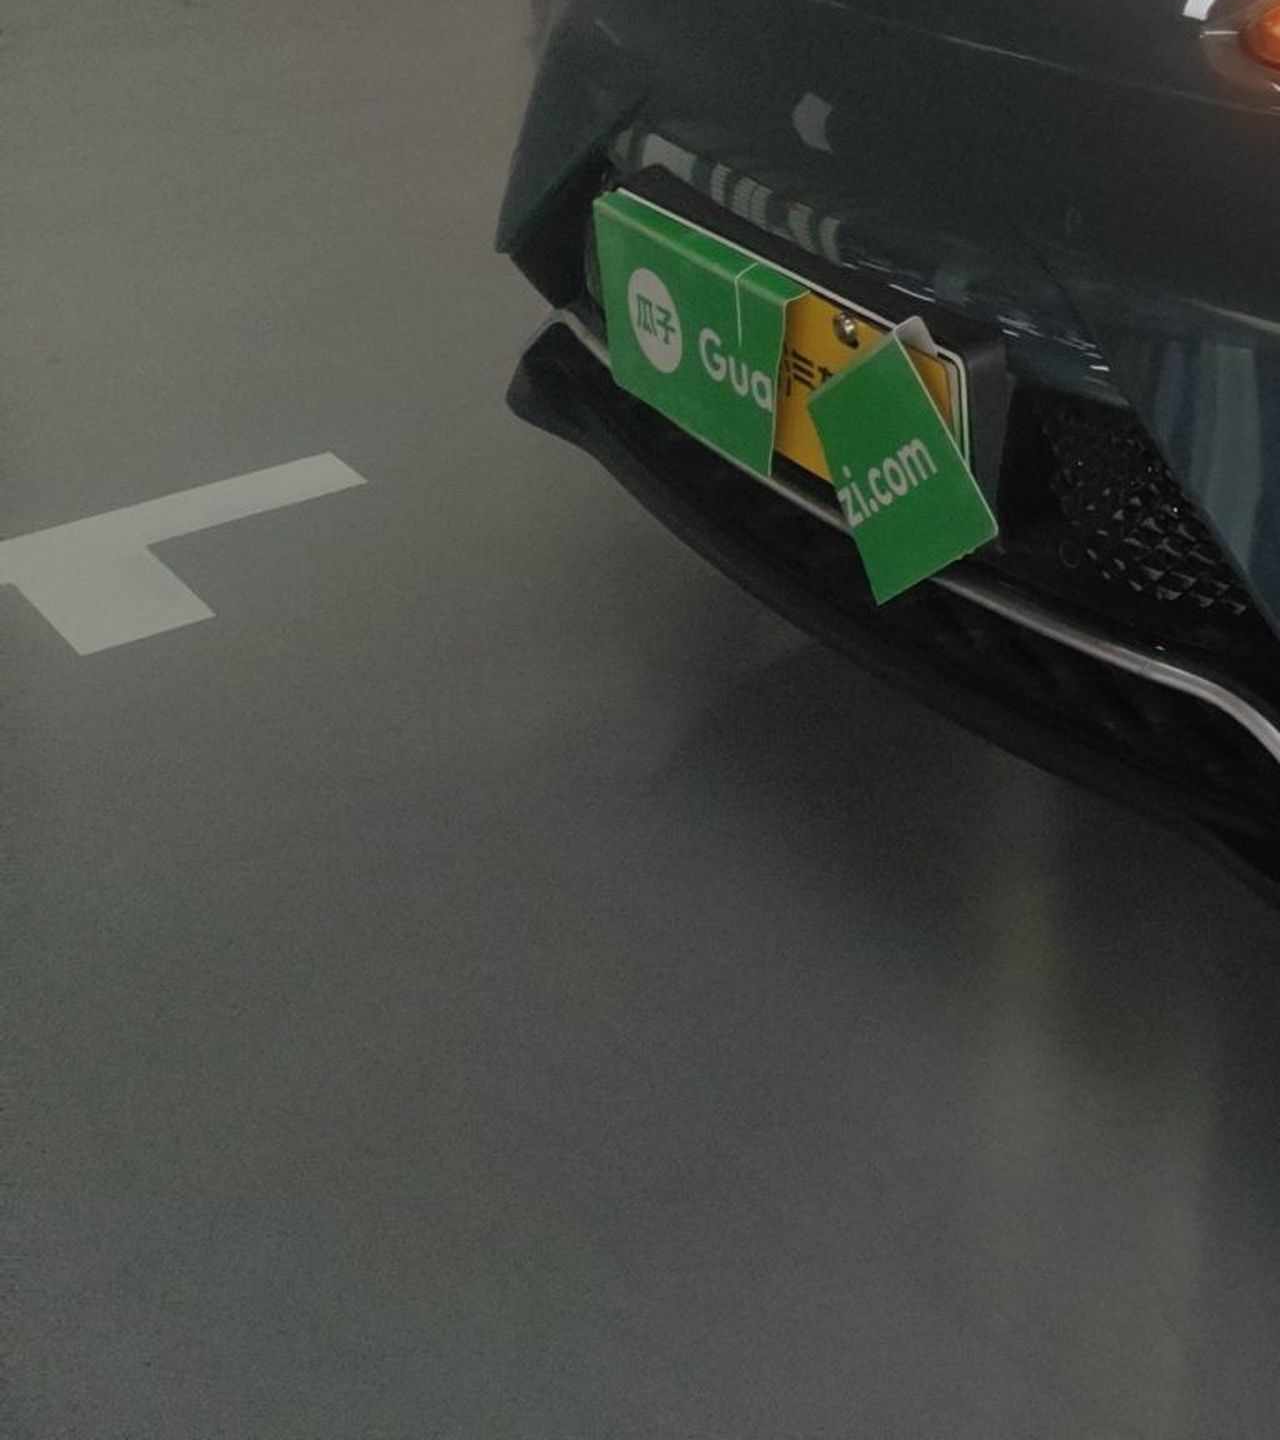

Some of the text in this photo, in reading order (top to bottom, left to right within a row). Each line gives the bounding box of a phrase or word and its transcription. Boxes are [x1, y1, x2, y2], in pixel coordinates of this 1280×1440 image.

[636, 295, 676, 345] 瓜子
[699, 327, 773, 413] Gua
[836, 438, 938, 527] zi.com
